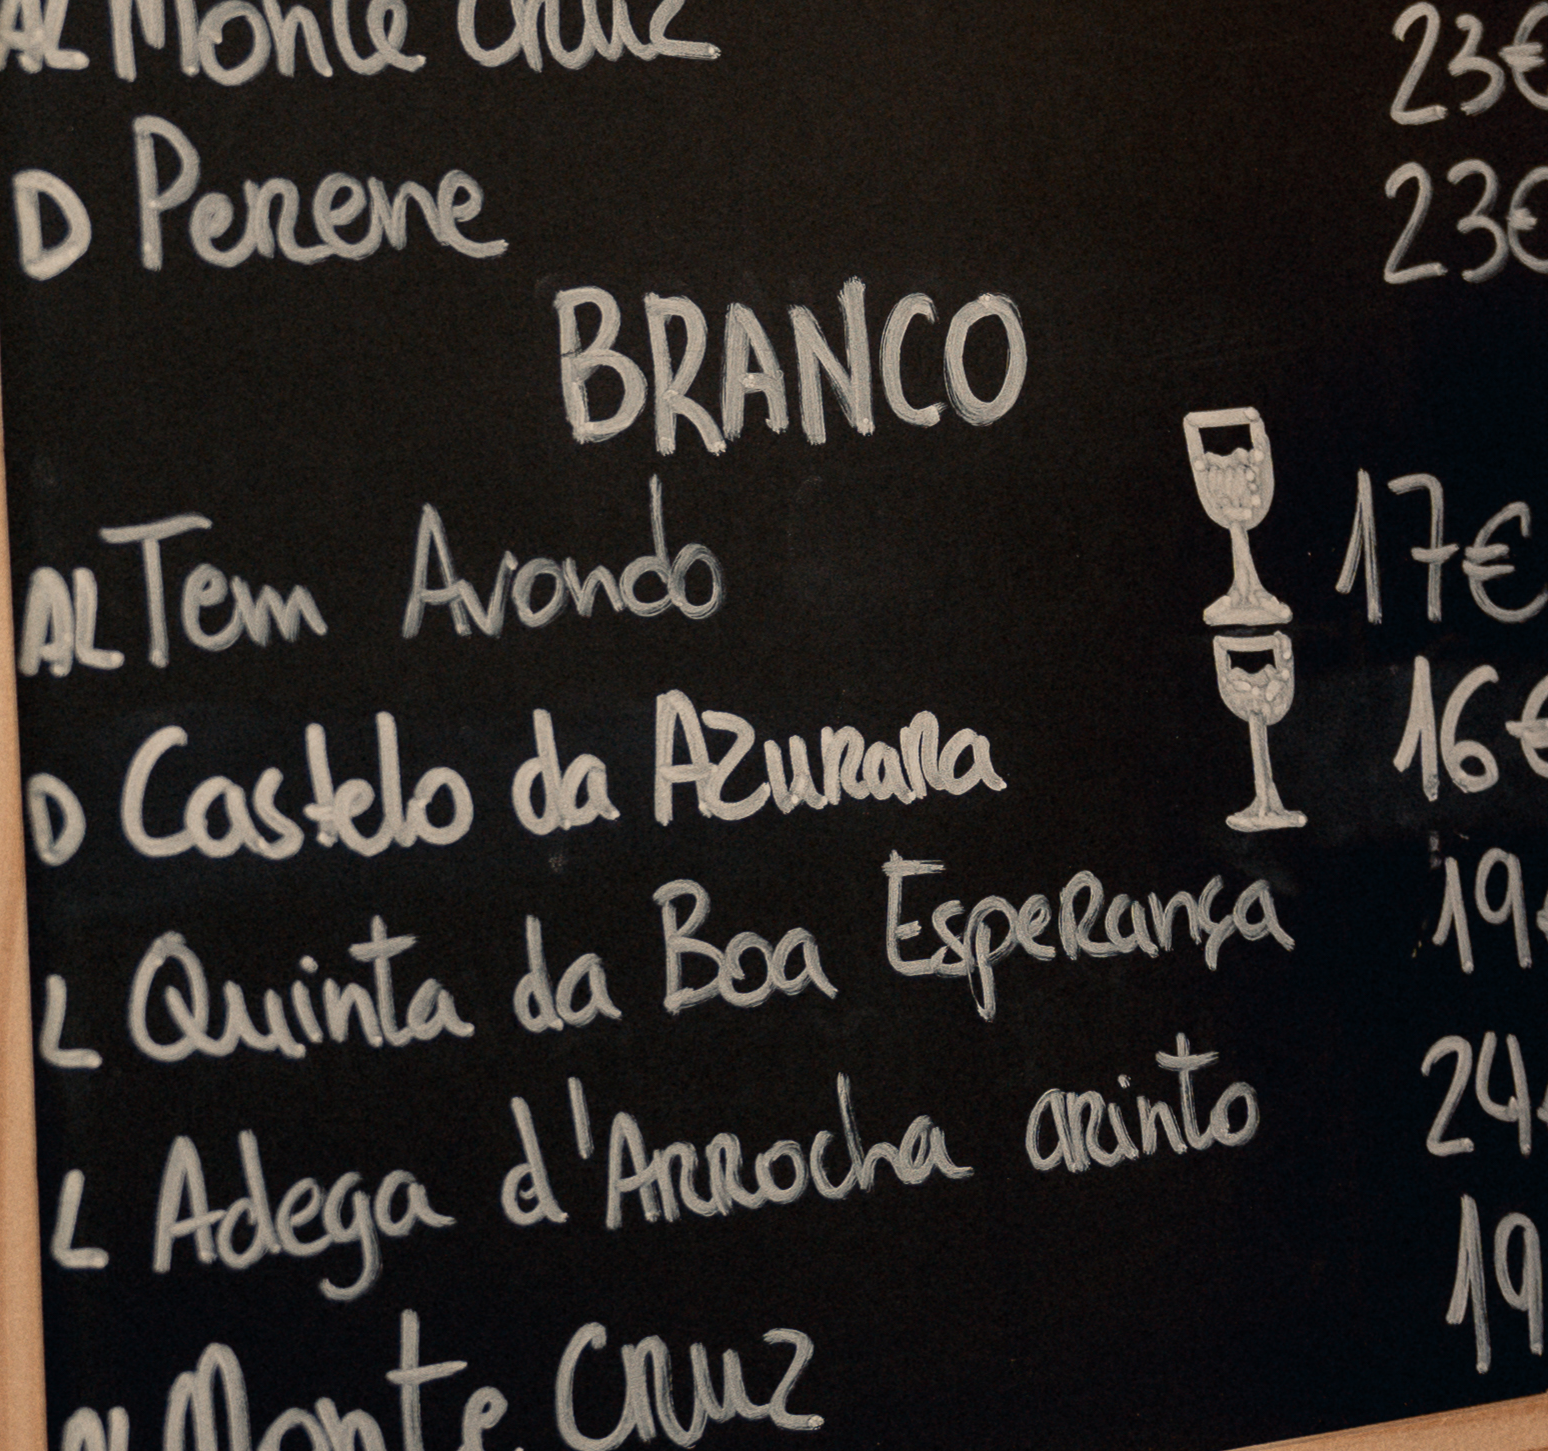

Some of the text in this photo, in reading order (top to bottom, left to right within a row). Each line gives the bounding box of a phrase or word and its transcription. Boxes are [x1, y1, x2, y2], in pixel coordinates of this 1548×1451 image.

[13, 169, 91, 281] D
[553, 276, 1027, 456] BRANCO
[20, 567, 124, 677] AL
[100, 515, 327, 668] Tem
[1336, 469, 1548, 623] 17€
[28, 773, 86, 866] D
[121, 711, 473, 860] Castelo
[512, 709, 620, 835] da
[41, 974, 102, 1068] L
[129, 915, 474, 1062] Quinta
[514, 915, 621, 1032] da
[653, 879, 838, 1015] Boa
[882, 850, 1295, 1021] Esperança
[52, 1170, 109, 1268] L
[154, 1130, 455, 1300] Adega
